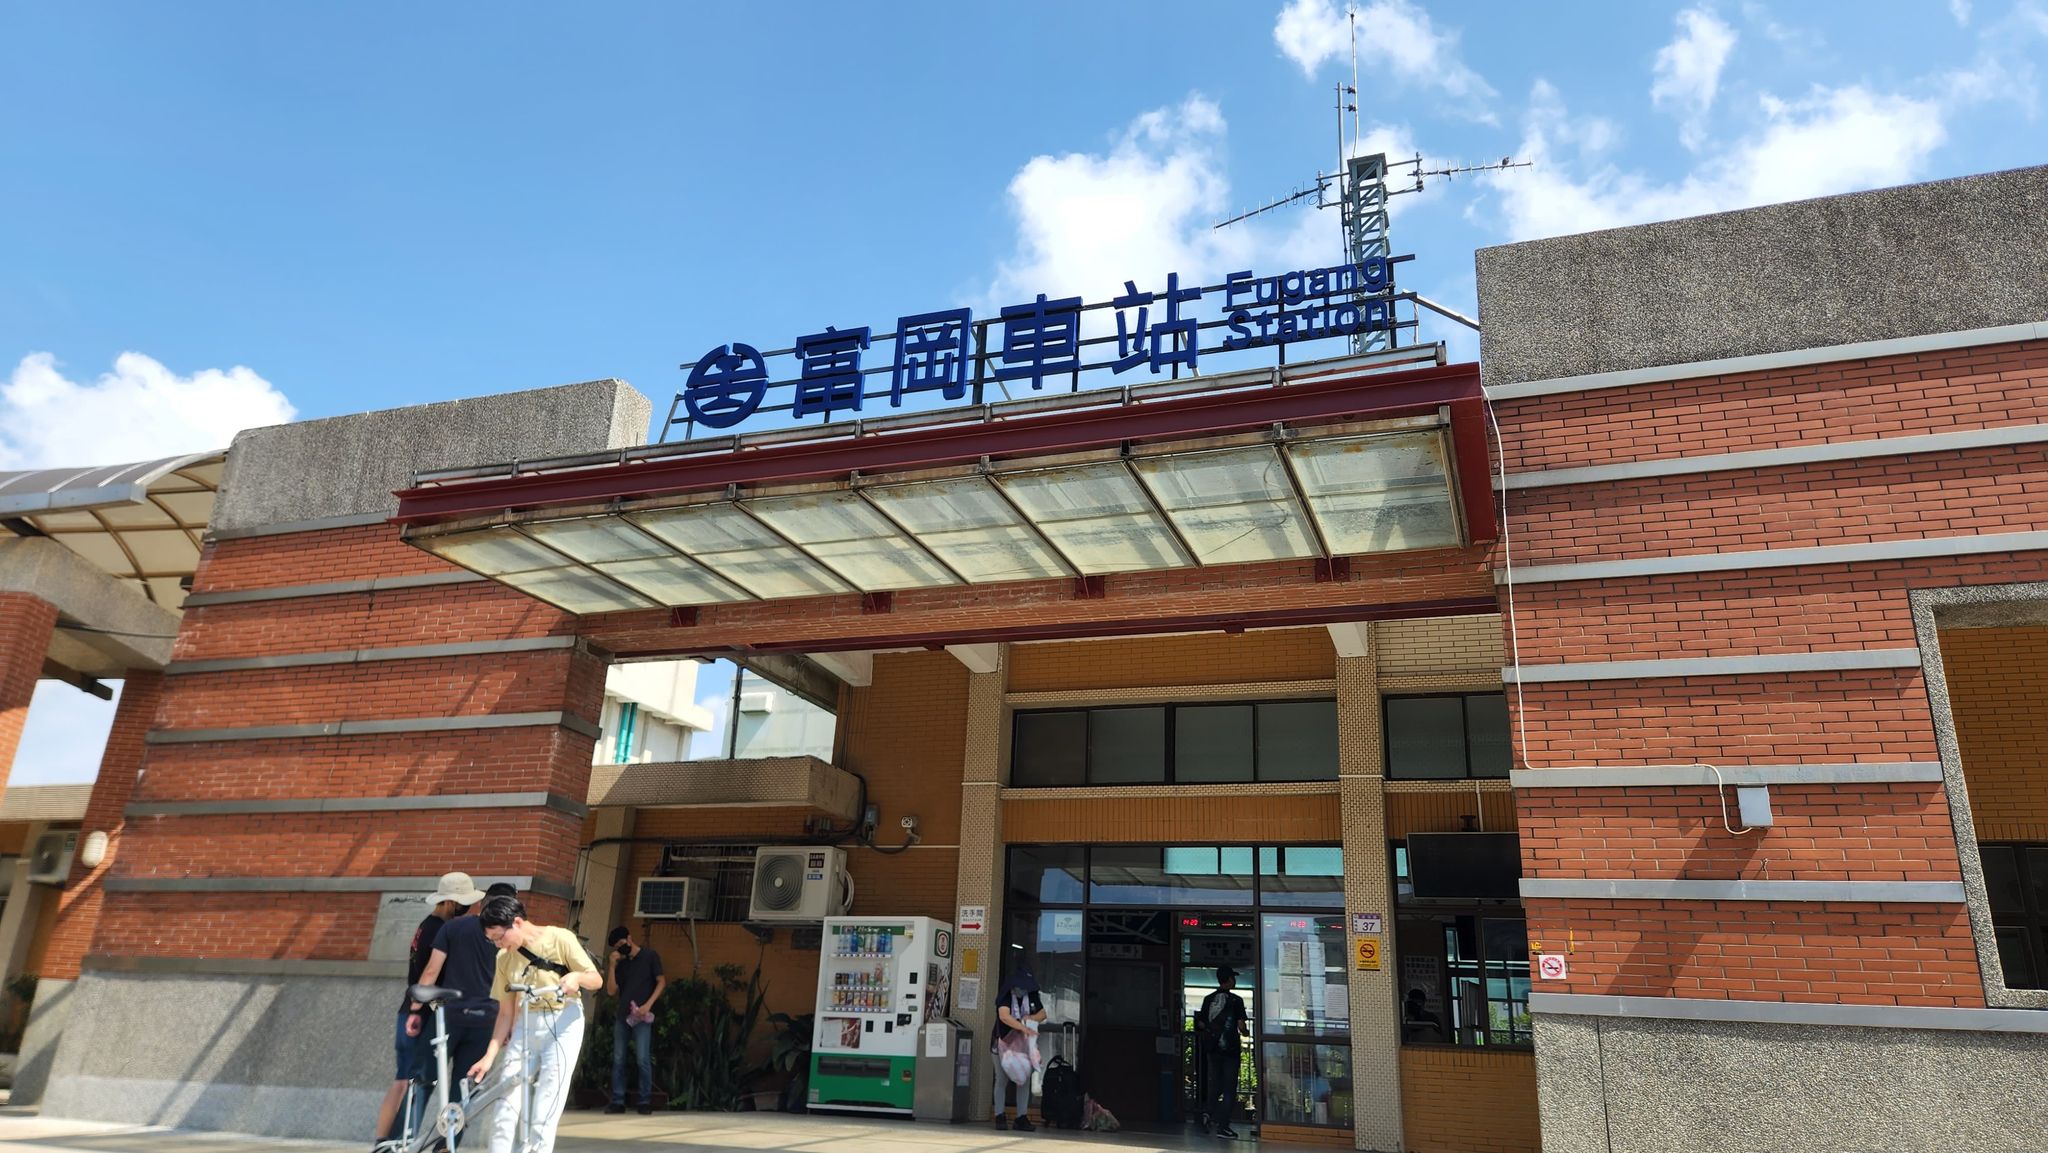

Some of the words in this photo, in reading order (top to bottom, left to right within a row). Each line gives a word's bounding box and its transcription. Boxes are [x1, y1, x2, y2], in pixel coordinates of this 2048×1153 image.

[1226, 255, 1387, 309] Fugang
[792, 271, 1202, 419] 富岡車站
[1226, 298, 1389, 349] Station
[1362, 922, 1375, 931] 37
